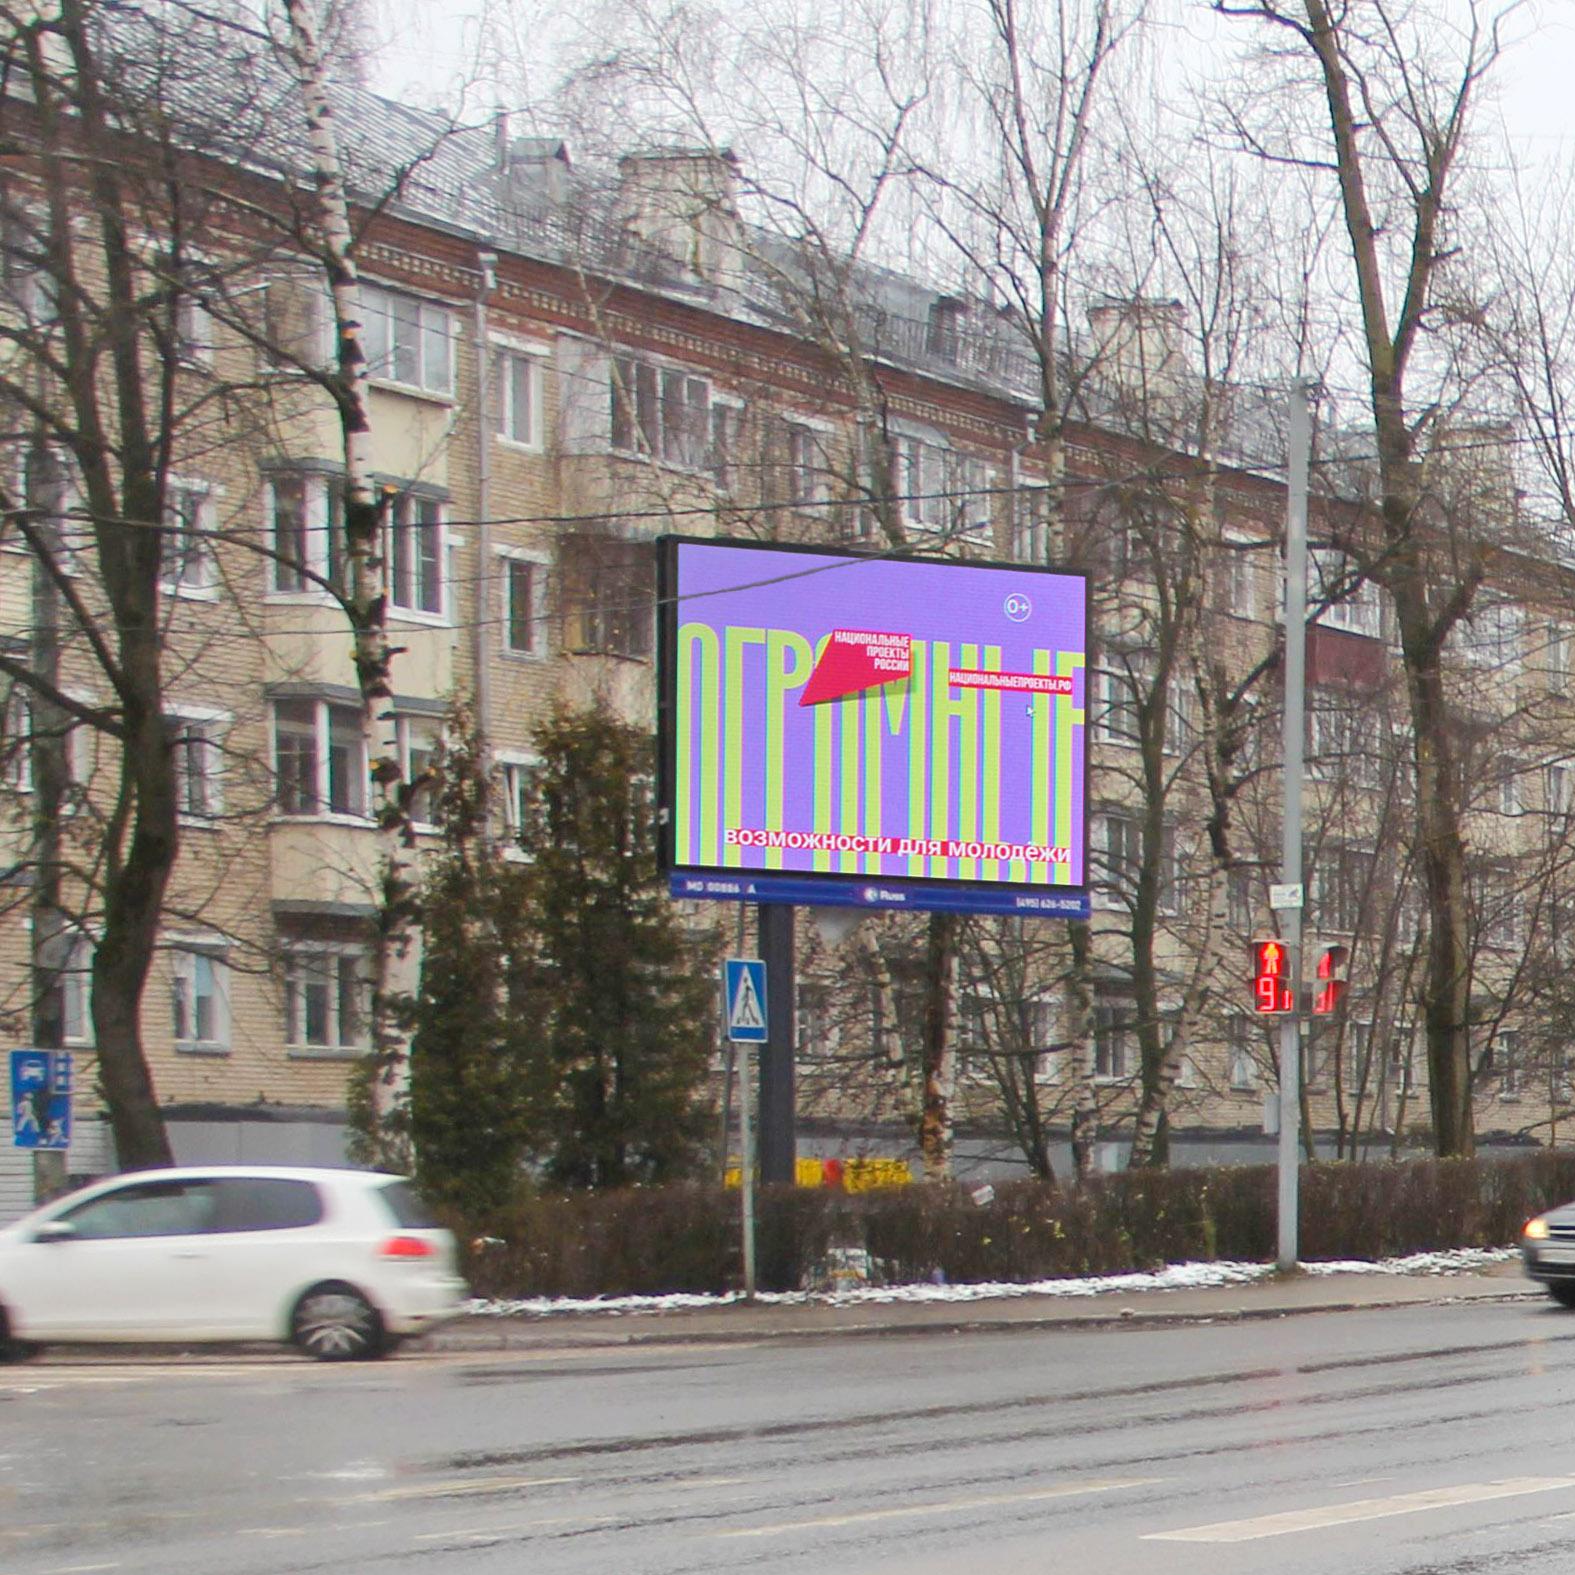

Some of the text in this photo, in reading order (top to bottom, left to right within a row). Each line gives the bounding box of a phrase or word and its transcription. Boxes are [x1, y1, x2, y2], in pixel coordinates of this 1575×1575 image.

[1007, 599, 1029, 614] 0+
[834, 630, 910, 648] НАЦИОНАЛЬНЫЕ
[866, 645, 910, 660] ПРОЕКТЫ
[874, 657, 910, 672] РОССИИ
